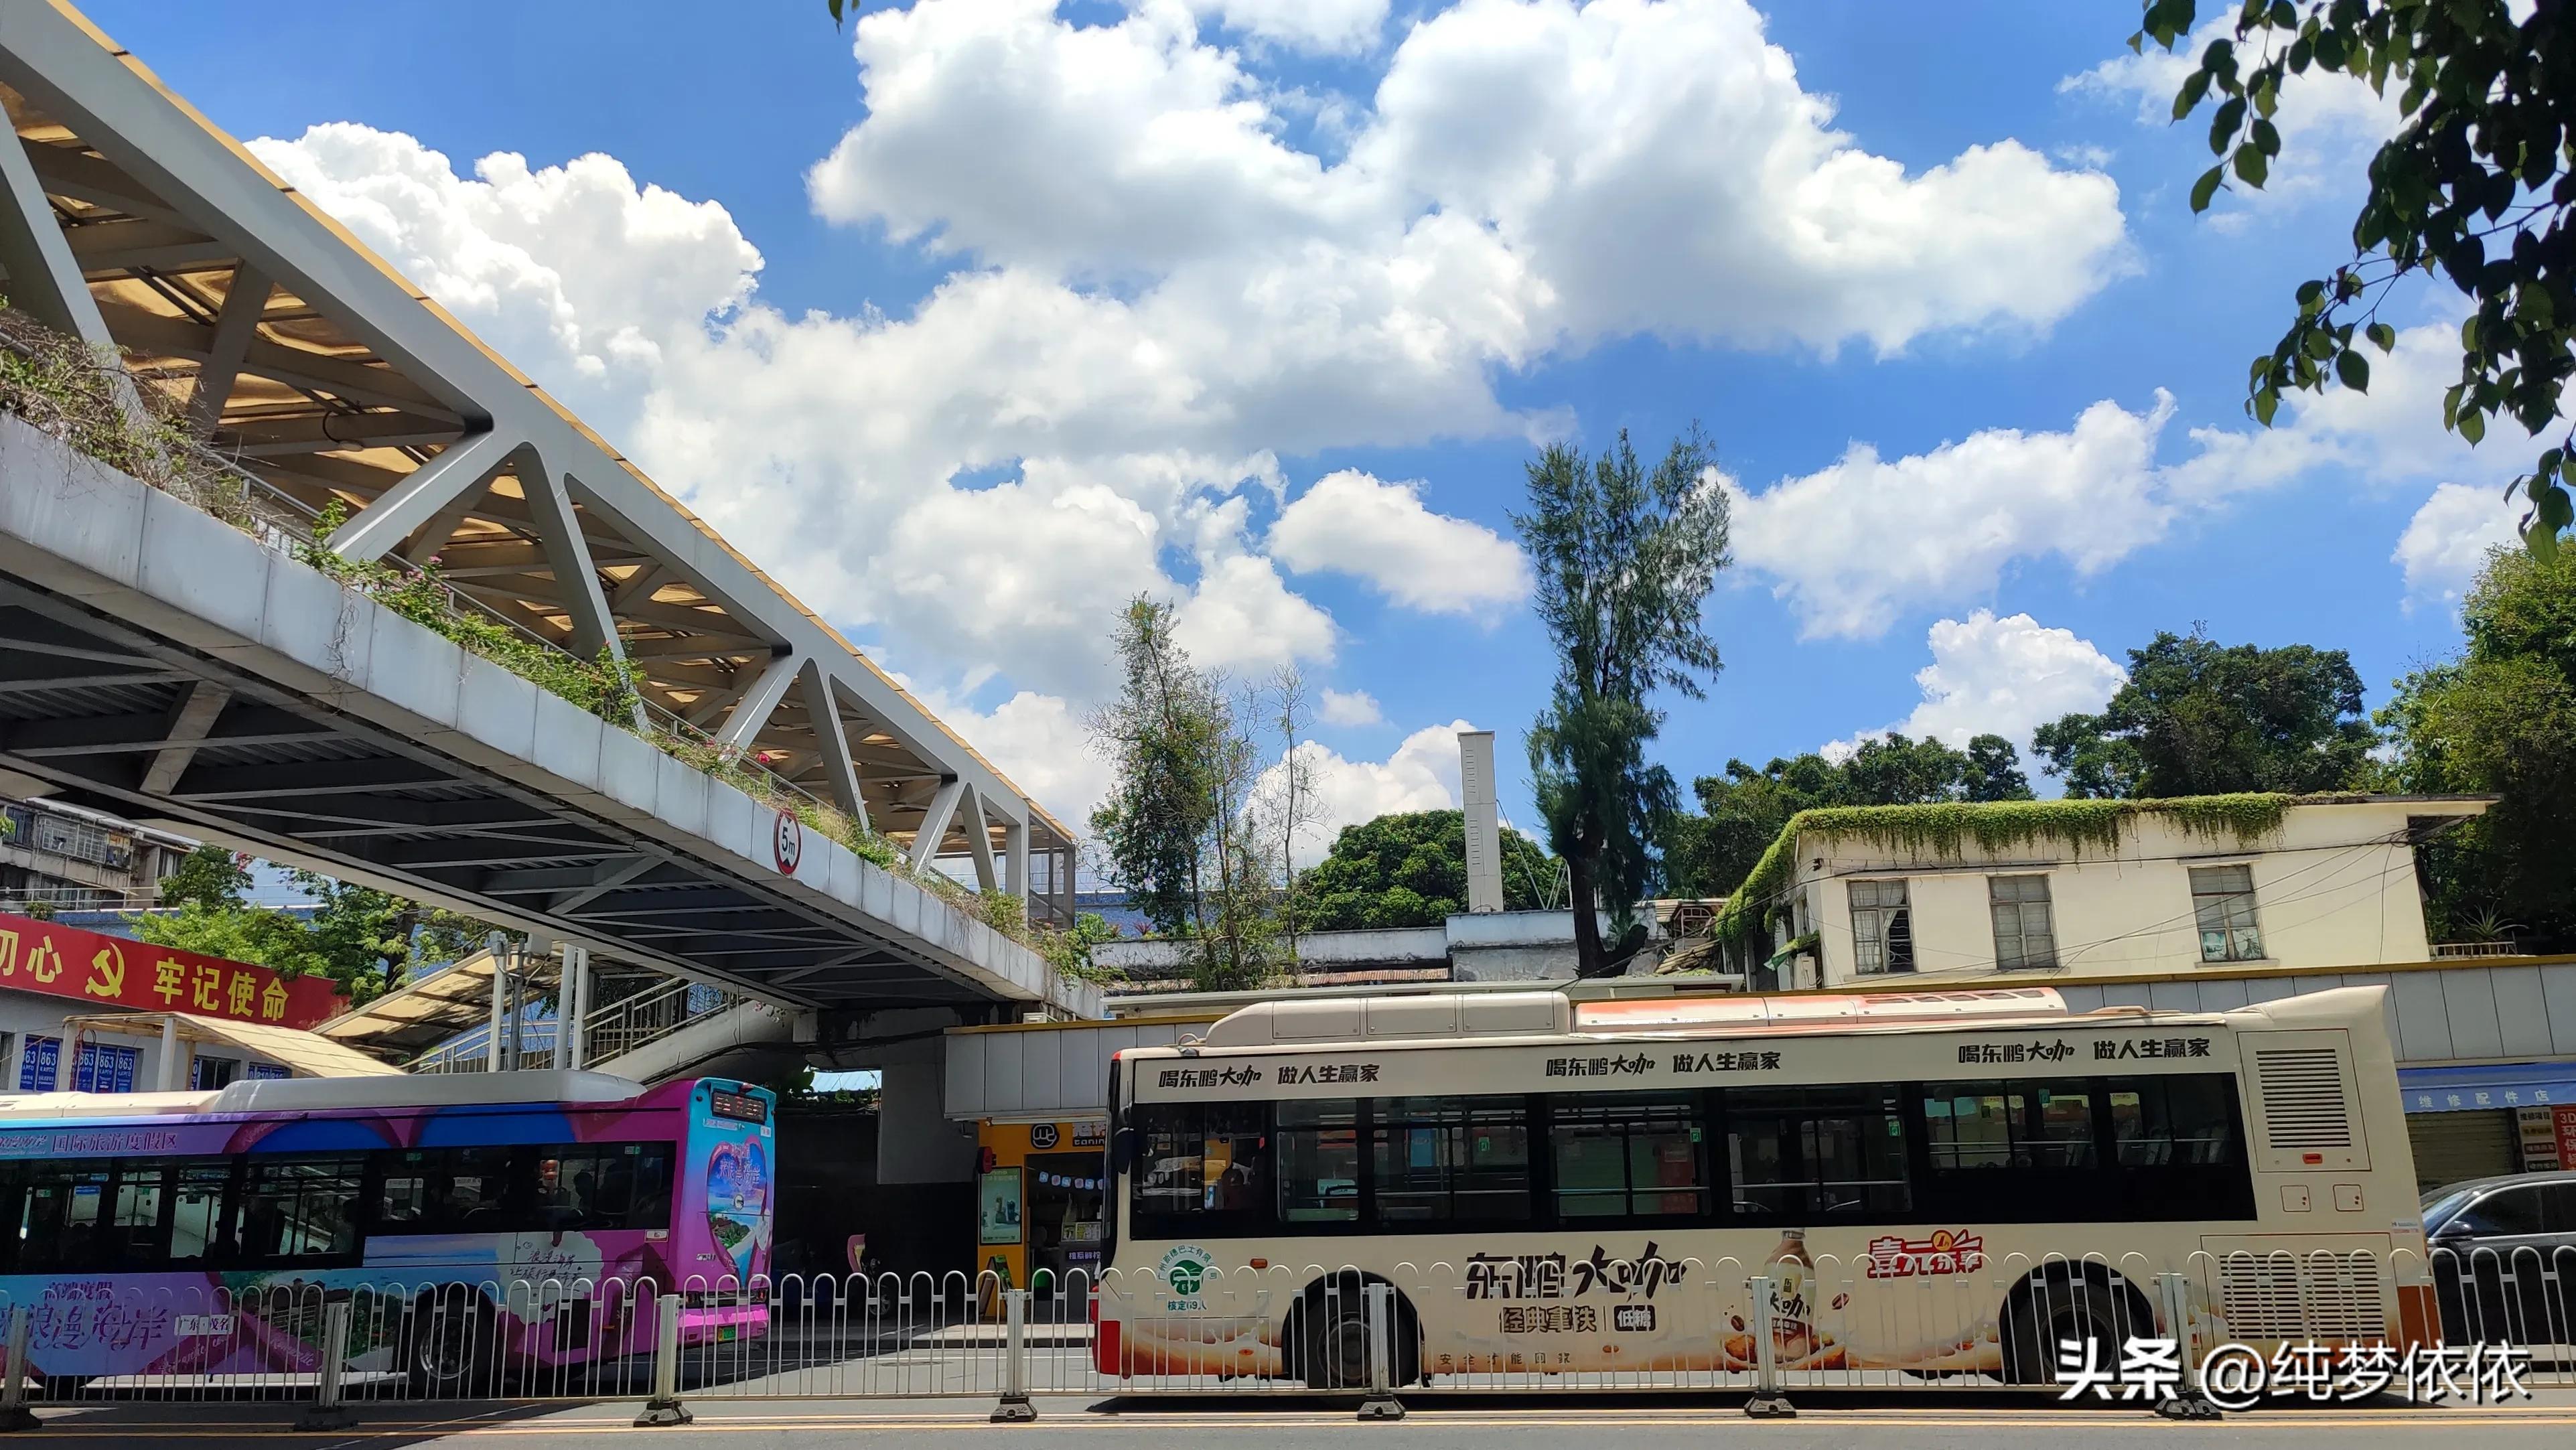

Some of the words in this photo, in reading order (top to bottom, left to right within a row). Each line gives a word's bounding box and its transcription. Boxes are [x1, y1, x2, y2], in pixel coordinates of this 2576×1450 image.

[153, 957, 289, 1021] 牢记使命
[24, 1050, 36, 1064] 63
[40, 1051, 56, 1066] 863
[99, 1054, 115, 1068] 863
[1958, 1038, 2075, 1064] 喝东鹏大咖
[2094, 1038, 2210, 1060] 做人生赢家
[118, 1056, 133, 1070] 863
[1545, 1052, 1656, 1077] 喝东鹏大咖
[1673, 1051, 1781, 1073] 做人生赢家
[1158, 1064, 1262, 1088] 喝东鹏大咖
[1277, 1064, 1380, 1085] 做人生赢家
[2419, 1089, 2550, 1108] 维修配件店
[52, 1131, 177, 1153] 国际旅游度假区
[1465, 1240, 1687, 1301] 东鹏大咖
[1499, 1305, 1597, 1333] 经典拿铁
[1616, 1308, 1654, 1329] 低糖
